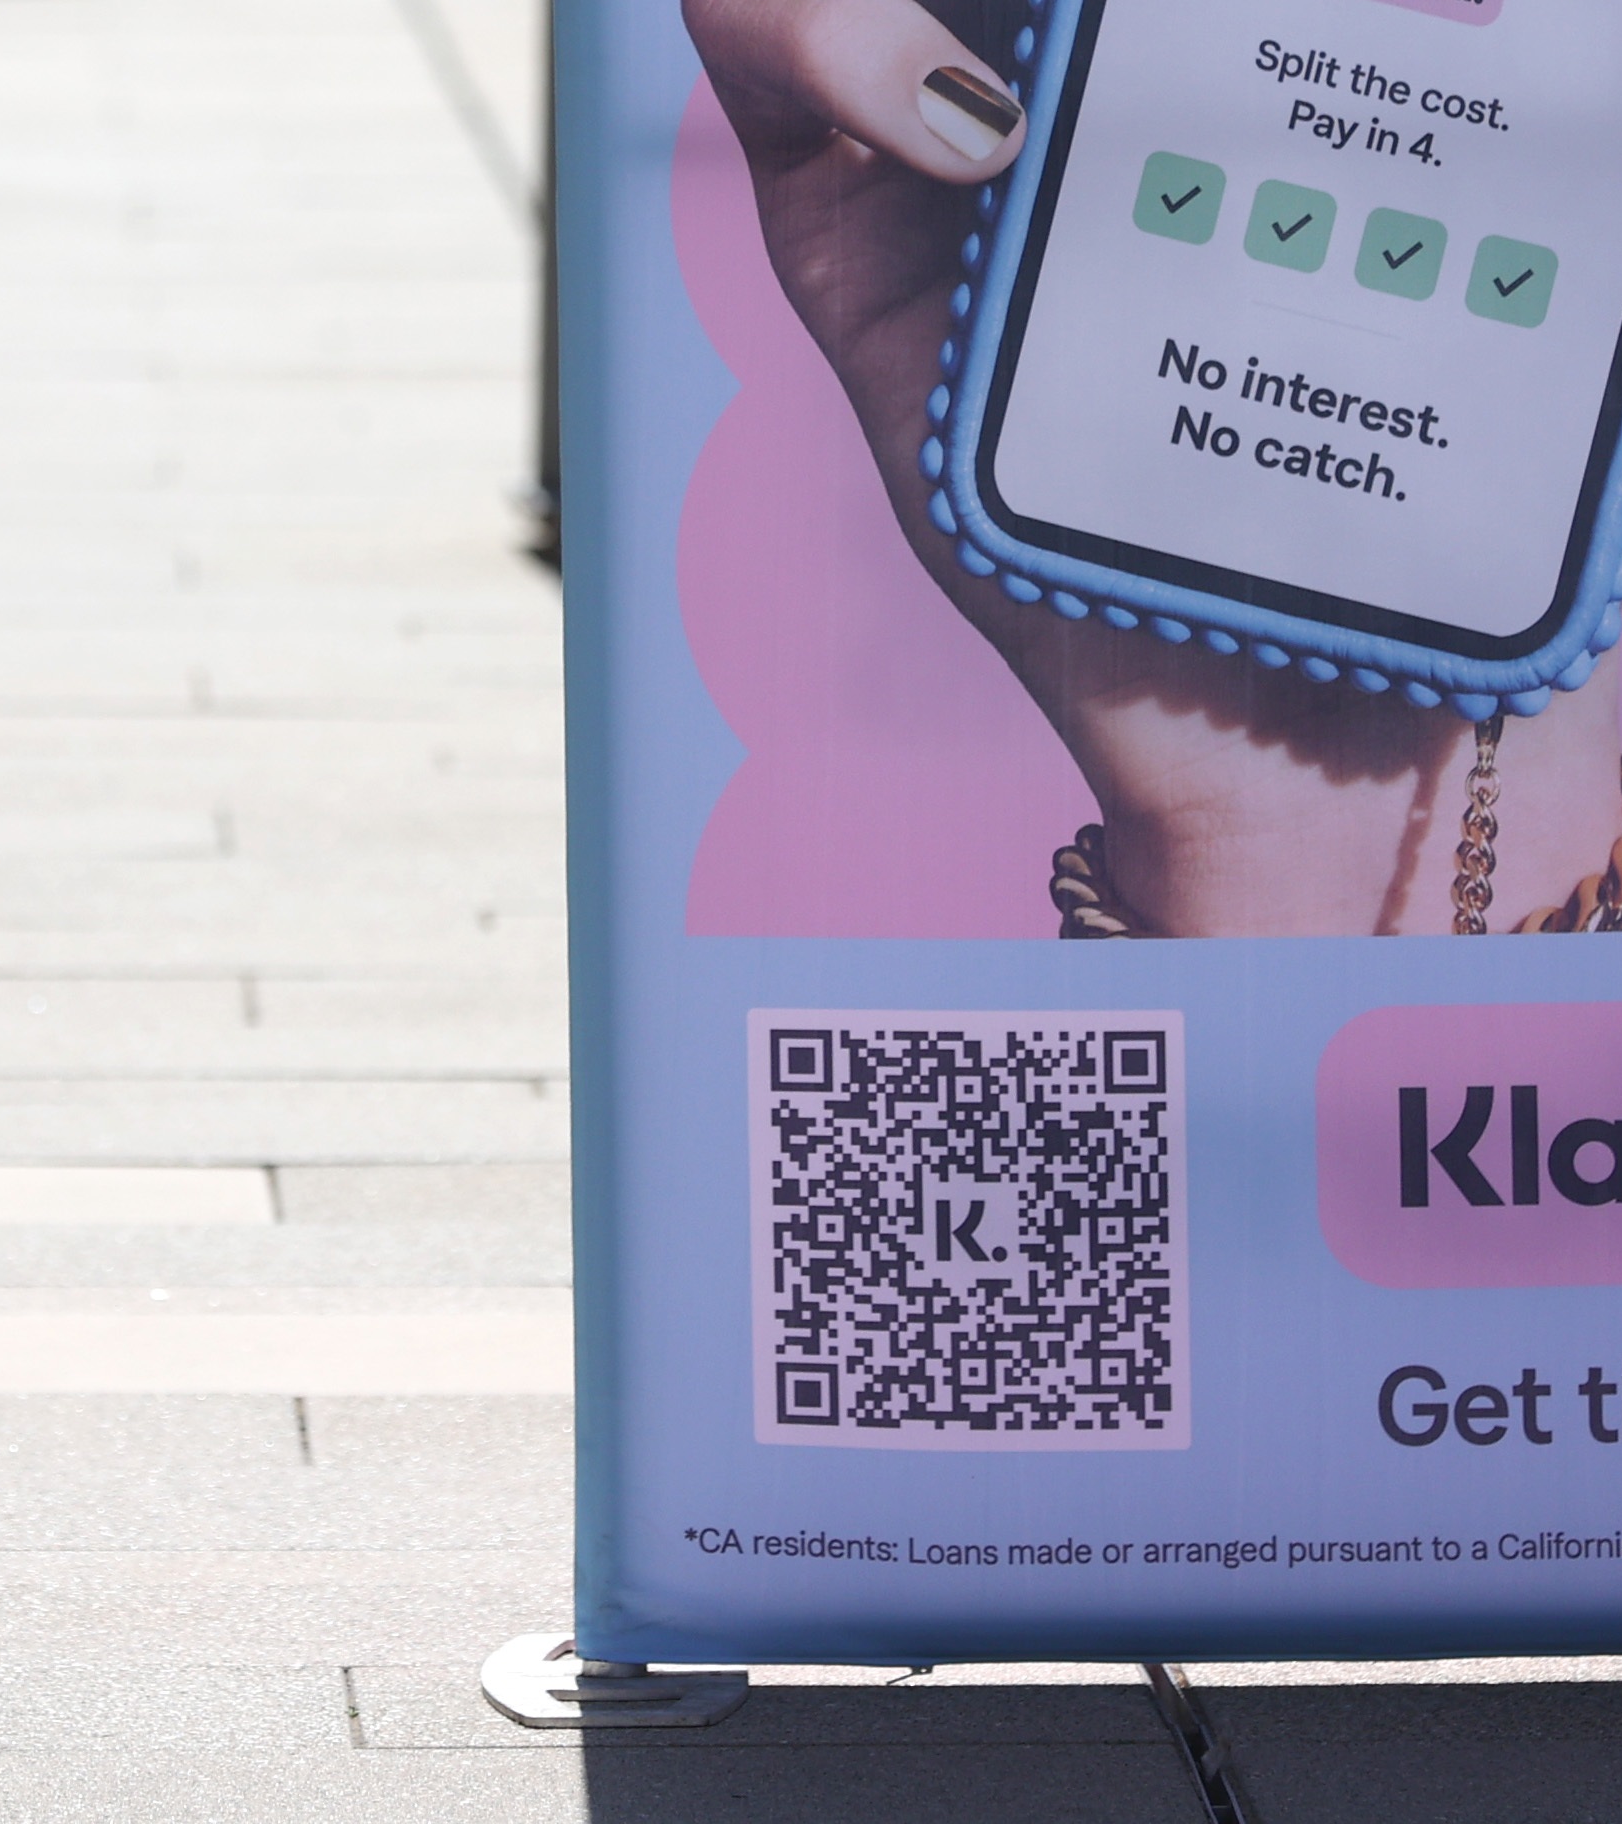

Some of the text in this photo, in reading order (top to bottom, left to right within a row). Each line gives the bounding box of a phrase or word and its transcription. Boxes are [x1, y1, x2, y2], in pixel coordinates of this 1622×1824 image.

[1255, 39, 1510, 132] Split the cost.
[1288, 99, 1442, 167] Pay in 4.
[1157, 338, 1448, 448] No interest.
[1170, 405, 1406, 502] No catch.
[935, 1199, 1008, 1263] K.
[1378, 1364, 1553, 1447] Get
[753, 1529, 899, 1563] residents:
[908, 1536, 999, 1566] Loans
[1008, 1536, 1093, 1566] made
[1101, 1543, 1135, 1565] or
[1143, 1534, 1278, 1570] arranged
[1288, 1536, 1423, 1569] pursuant
[1431, 1536, 1462, 1562] to
[1471, 1539, 1489, 1561] a
